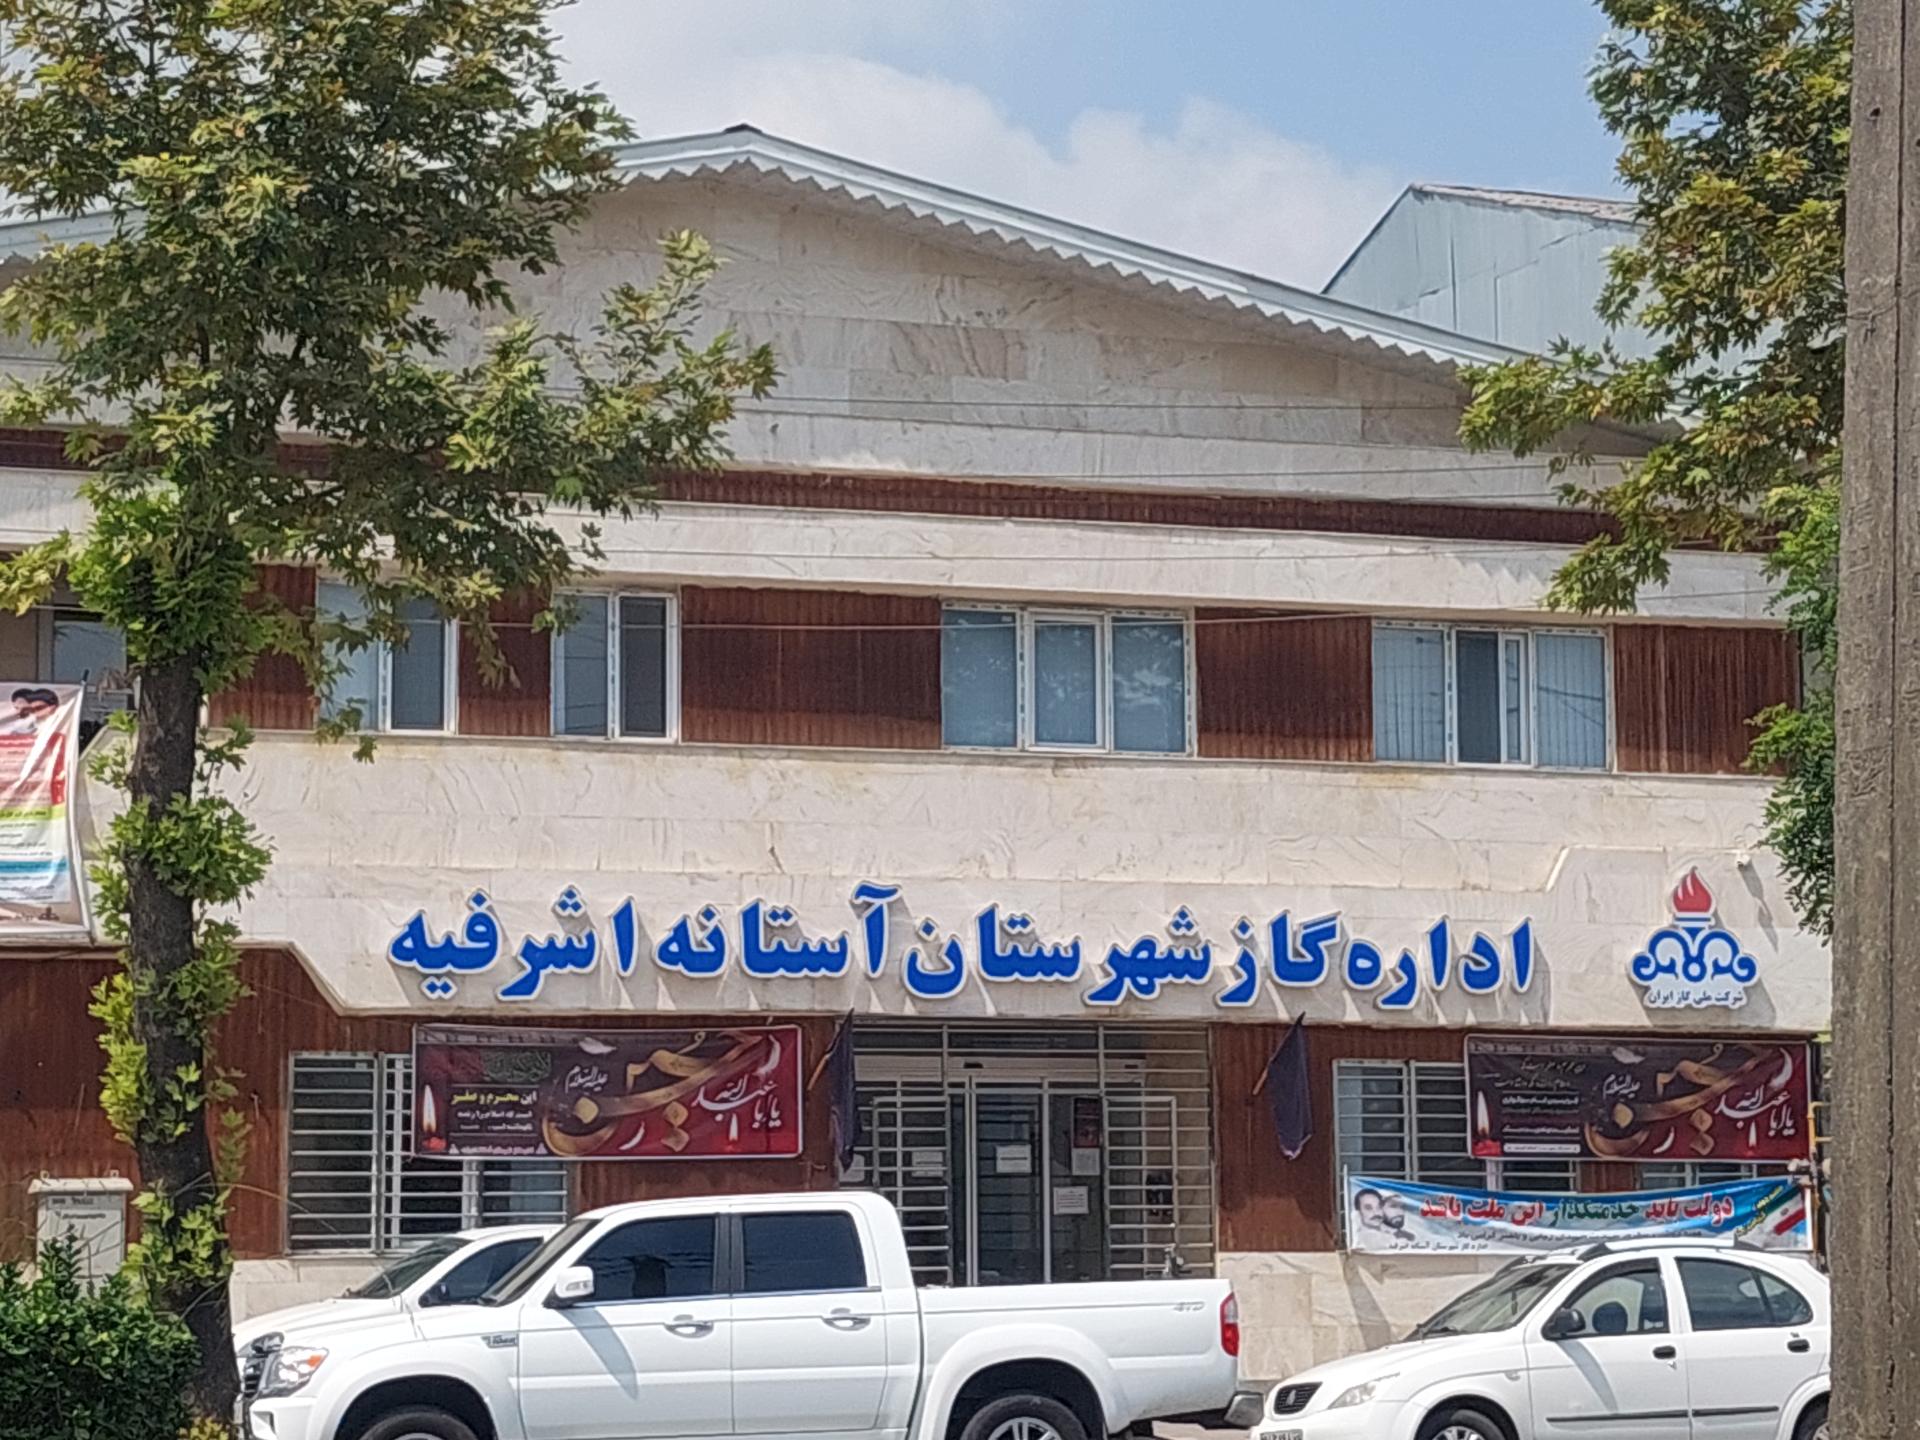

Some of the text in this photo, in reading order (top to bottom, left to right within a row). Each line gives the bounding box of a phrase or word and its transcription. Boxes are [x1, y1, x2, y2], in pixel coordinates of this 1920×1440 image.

[391, 882, 1531, 1006] اداره گاز شهرستان آستانه اشرفیه
[1648, 989, 1743, 1006] شرکت ملی گاز ایران
[1467, 1199, 1505, 1220] ملت
[1645, 1197, 1678, 1222] باید
[1684, 1194, 1733, 1224] دولت
